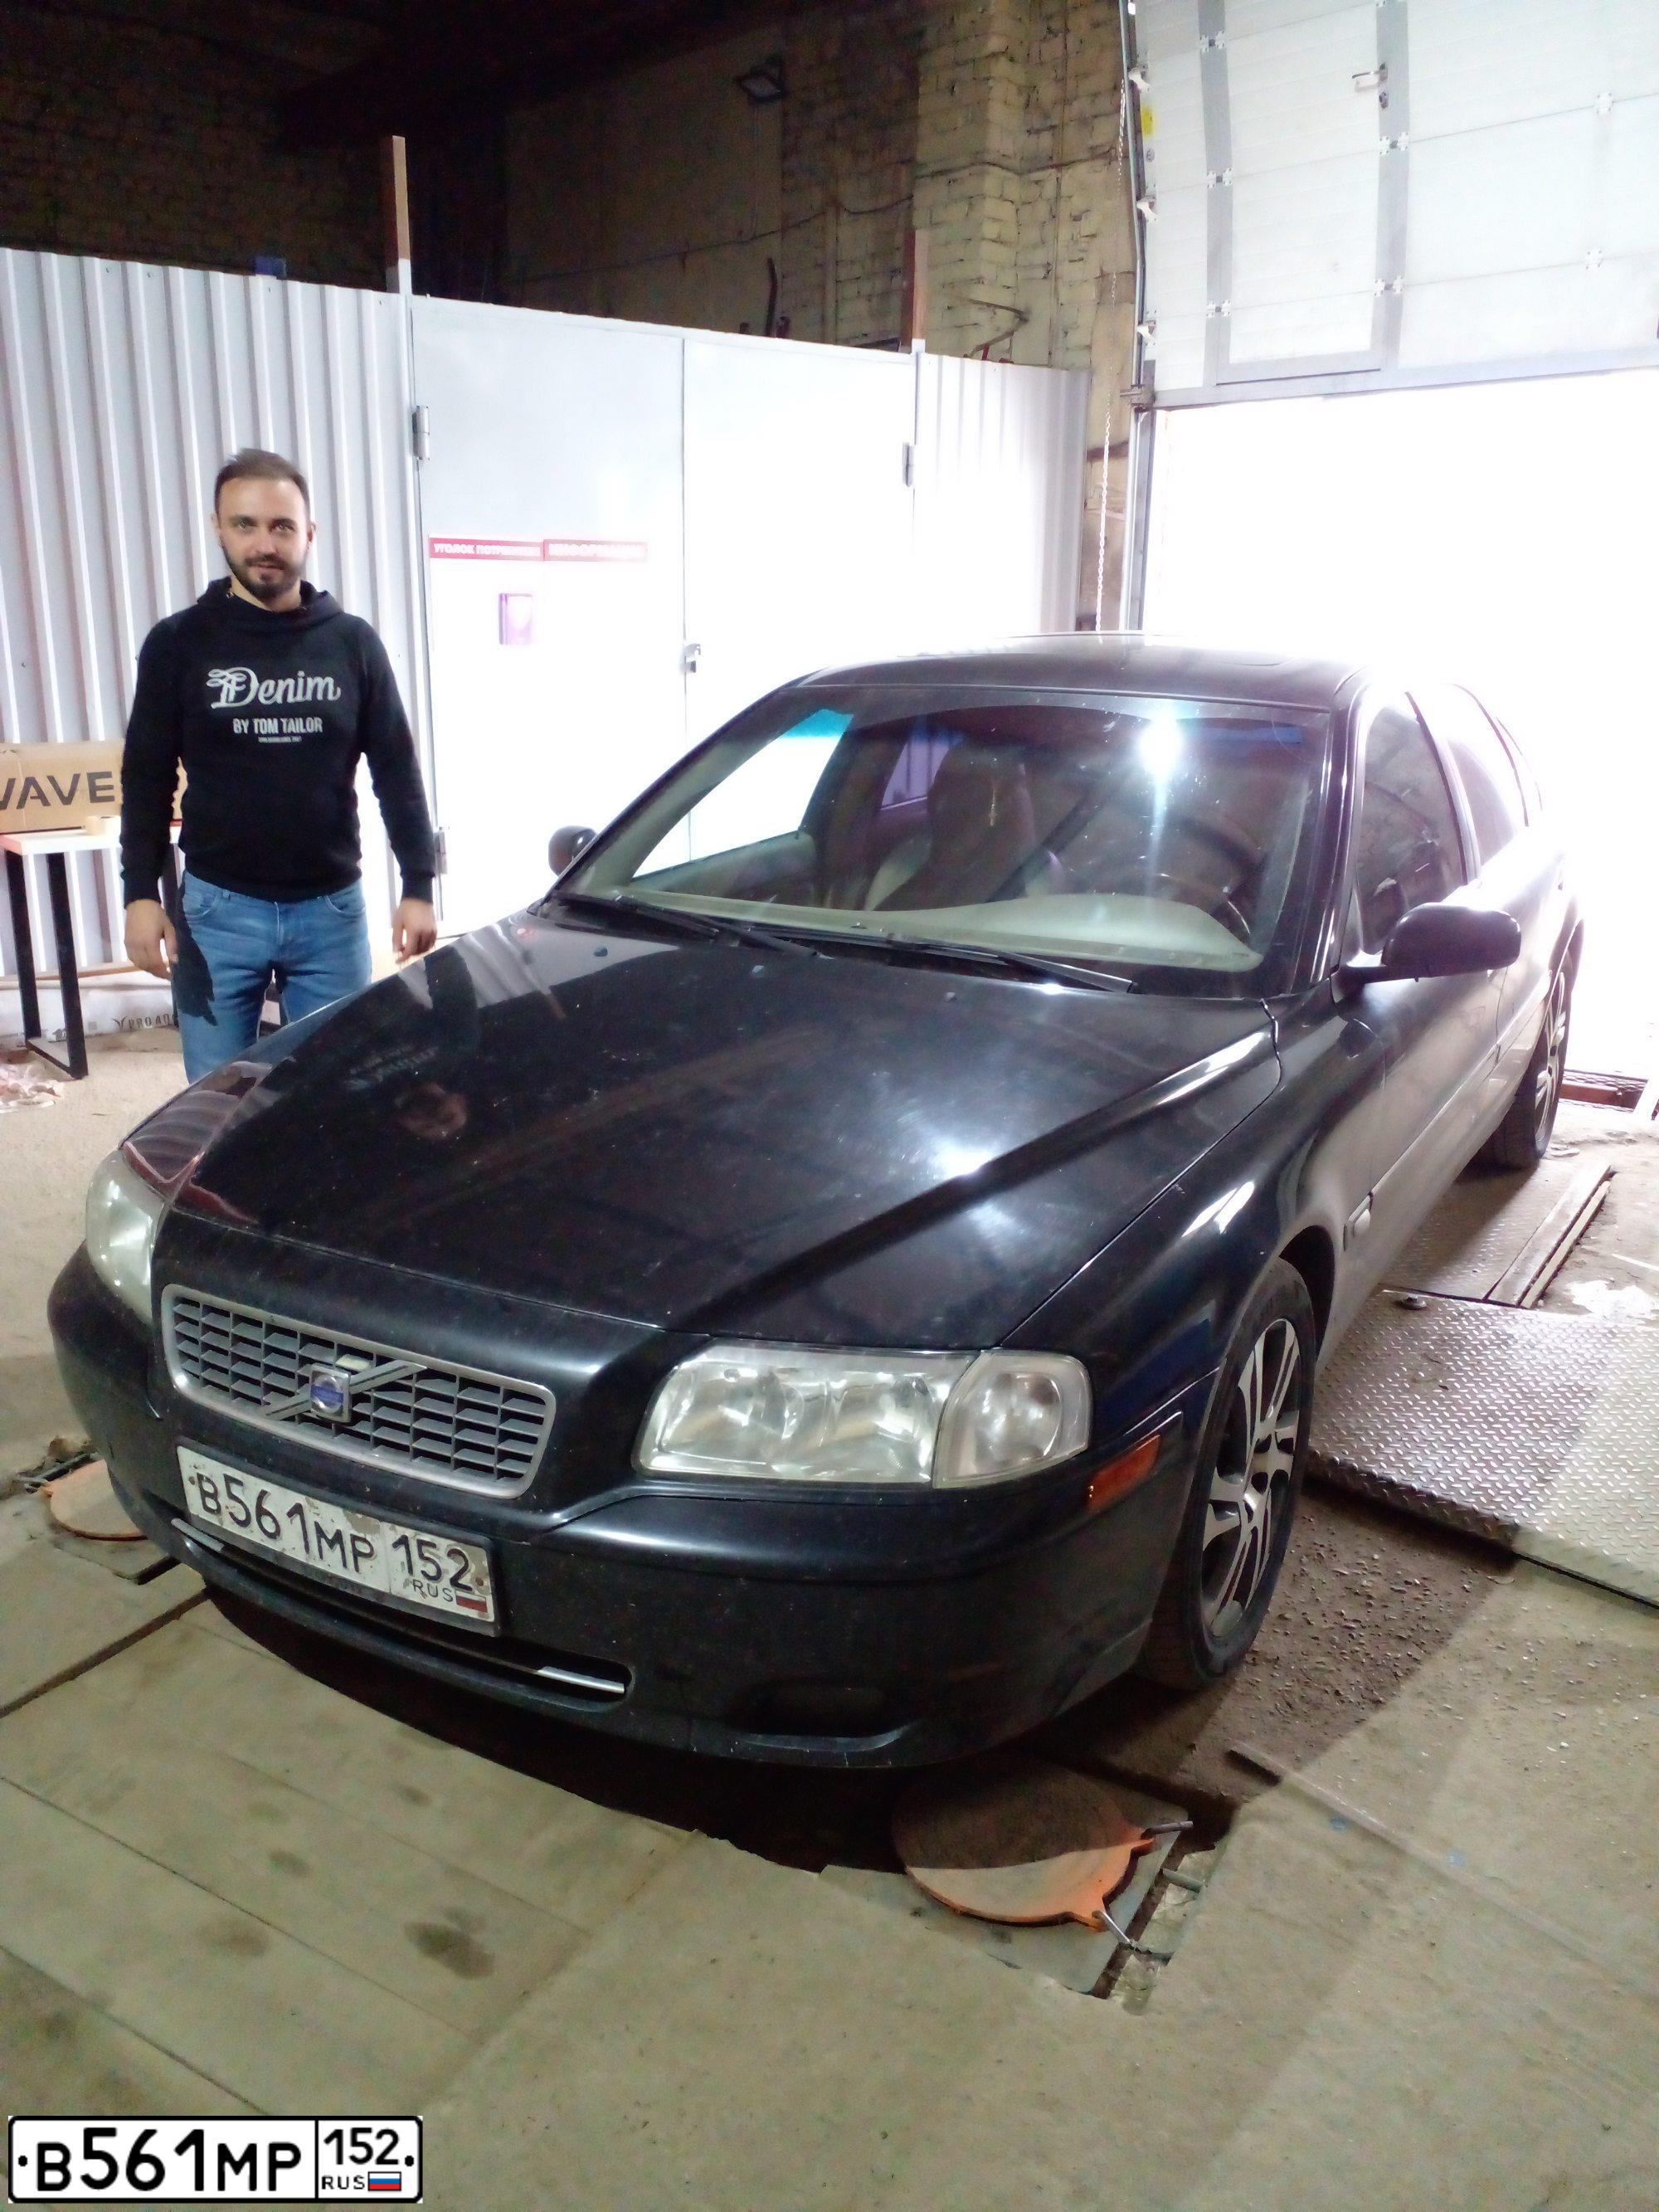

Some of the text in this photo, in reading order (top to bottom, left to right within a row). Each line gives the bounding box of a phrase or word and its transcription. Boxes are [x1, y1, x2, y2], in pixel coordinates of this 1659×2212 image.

[206, 666, 342, 710] Denim
[232, 716, 324, 734] BY TOM TAILOR
[392, 1533, 473, 1591] 152
[411, 1578, 455, 1602] RUS
